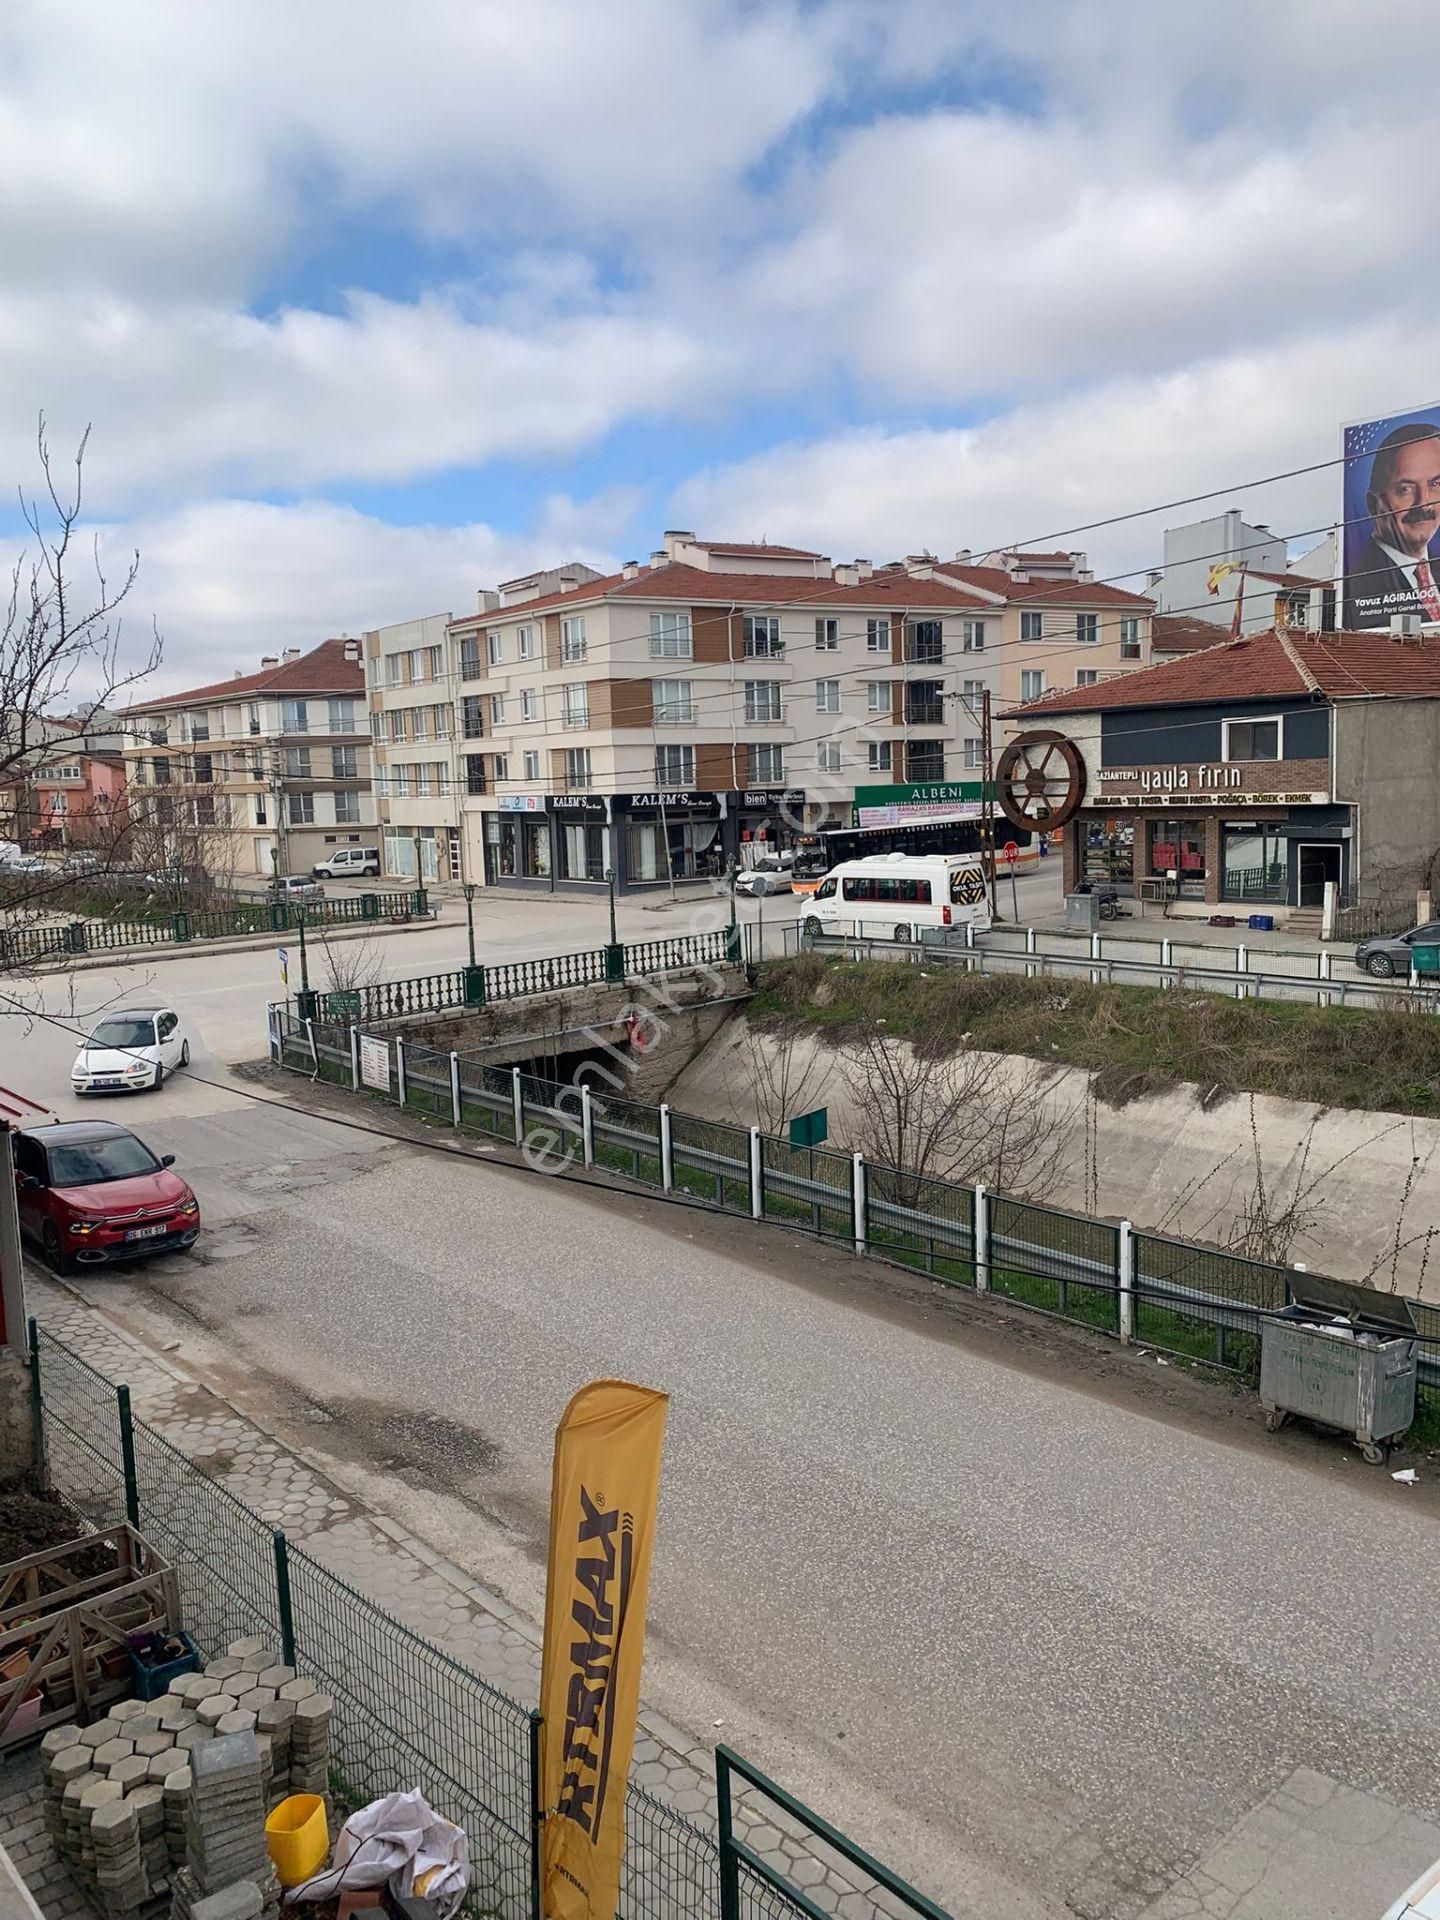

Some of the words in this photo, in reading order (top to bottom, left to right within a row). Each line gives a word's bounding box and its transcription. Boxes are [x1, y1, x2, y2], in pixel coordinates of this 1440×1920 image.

[1355, 598, 1381, 607] Yavuz
[1359, 608, 1382, 616] Anahtar
[1383, 606, 1397, 614] Parti
[1398, 604, 1416, 612] Genel
[1141, 765, 1189, 792] yayla
[553, 796, 587, 808] KALEM'S
[631, 793, 688, 806] KALEM'S
[746, 794, 765, 804] bien
[1141, 796, 1162, 805] PASTA
[1190, 795, 1212, 804] PASTA
[1252, 793, 1279, 803] BÖREK
[1284, 793, 1312, 803] EKMEK
[1005, 847, 1018, 858] DUR
